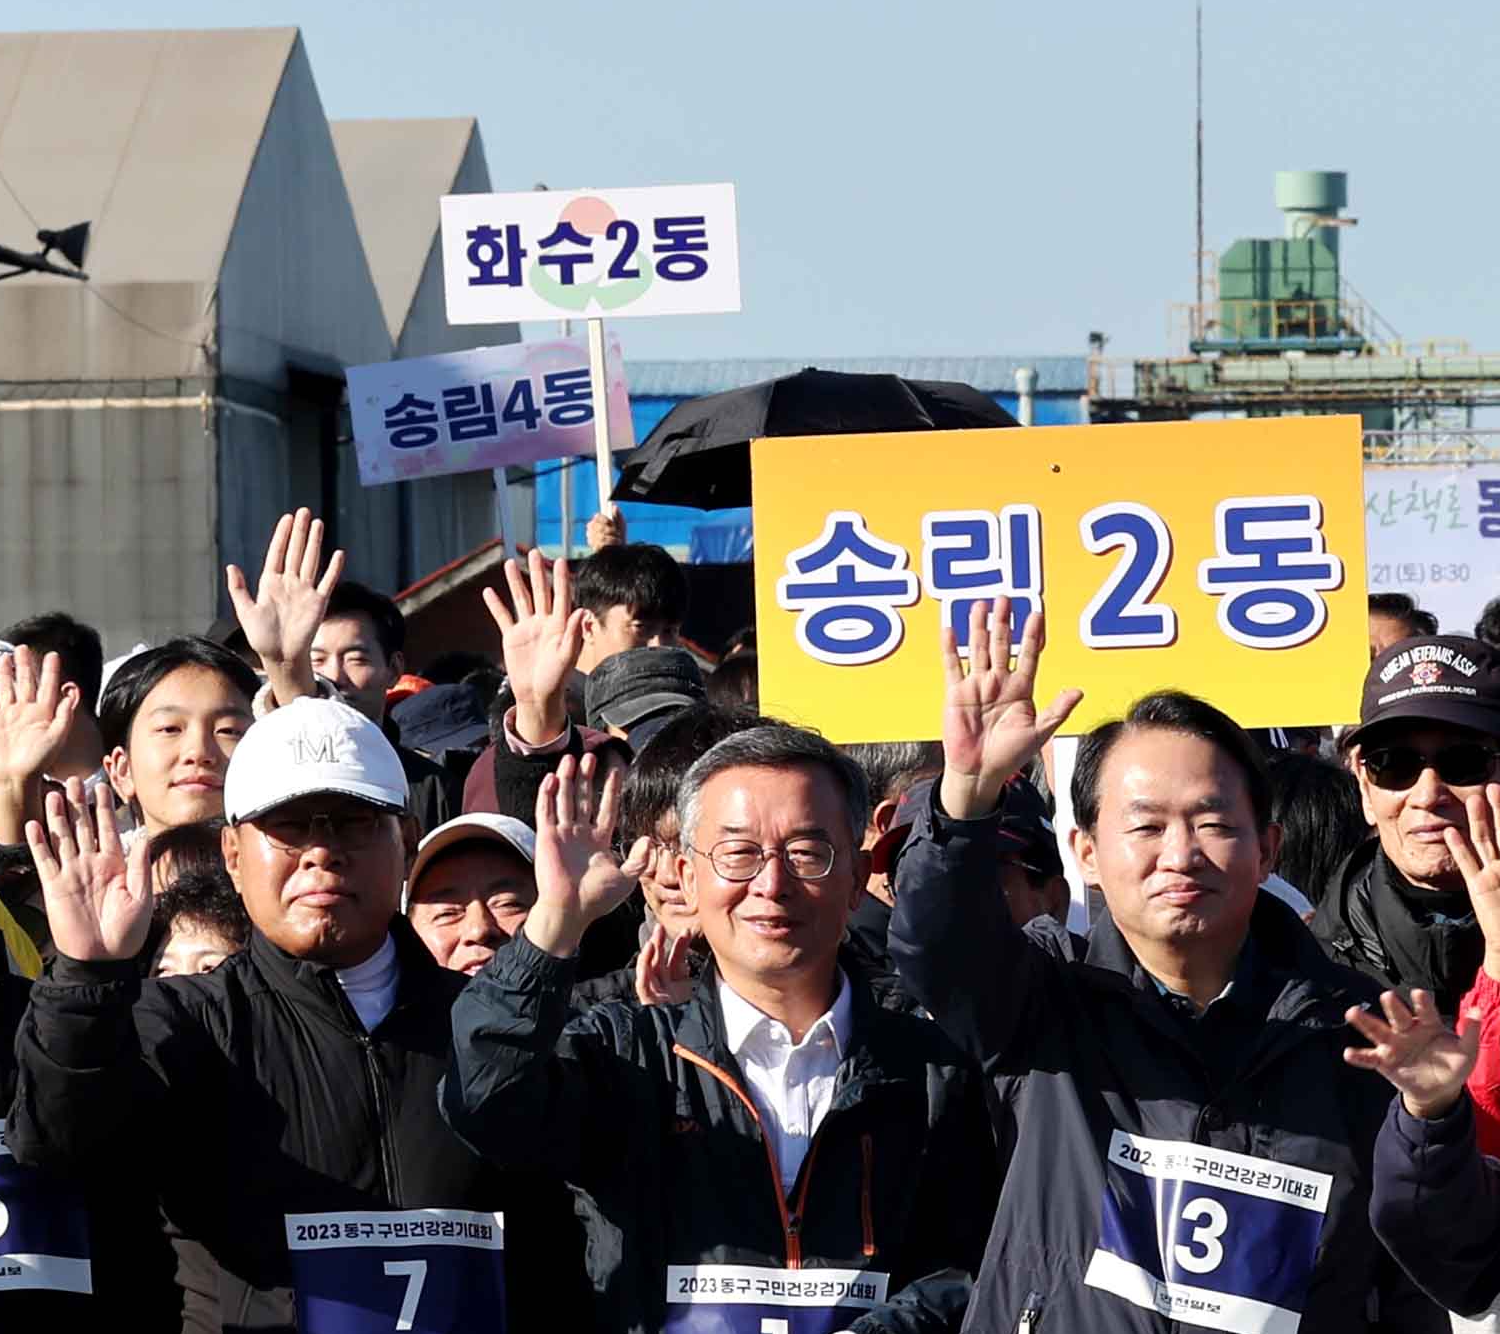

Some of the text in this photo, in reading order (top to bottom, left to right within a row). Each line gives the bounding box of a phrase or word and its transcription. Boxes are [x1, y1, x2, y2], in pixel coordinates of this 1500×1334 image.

[466, 216, 709, 287] 화수2동
[384, 369, 596, 450] 송림4동
[1430, 563, 1470, 584] 8:30
[1192, 1156, 1319, 1202] 구민건강걷기대회
[296, 1222, 492, 1242] 2023 동구 구민건강걷기대회
[1174, 1198, 1228, 1274] 3
[383, 1260, 429, 1331] 7
[679, 1276, 877, 1301] 2023 동구 구민건강걷기대회
